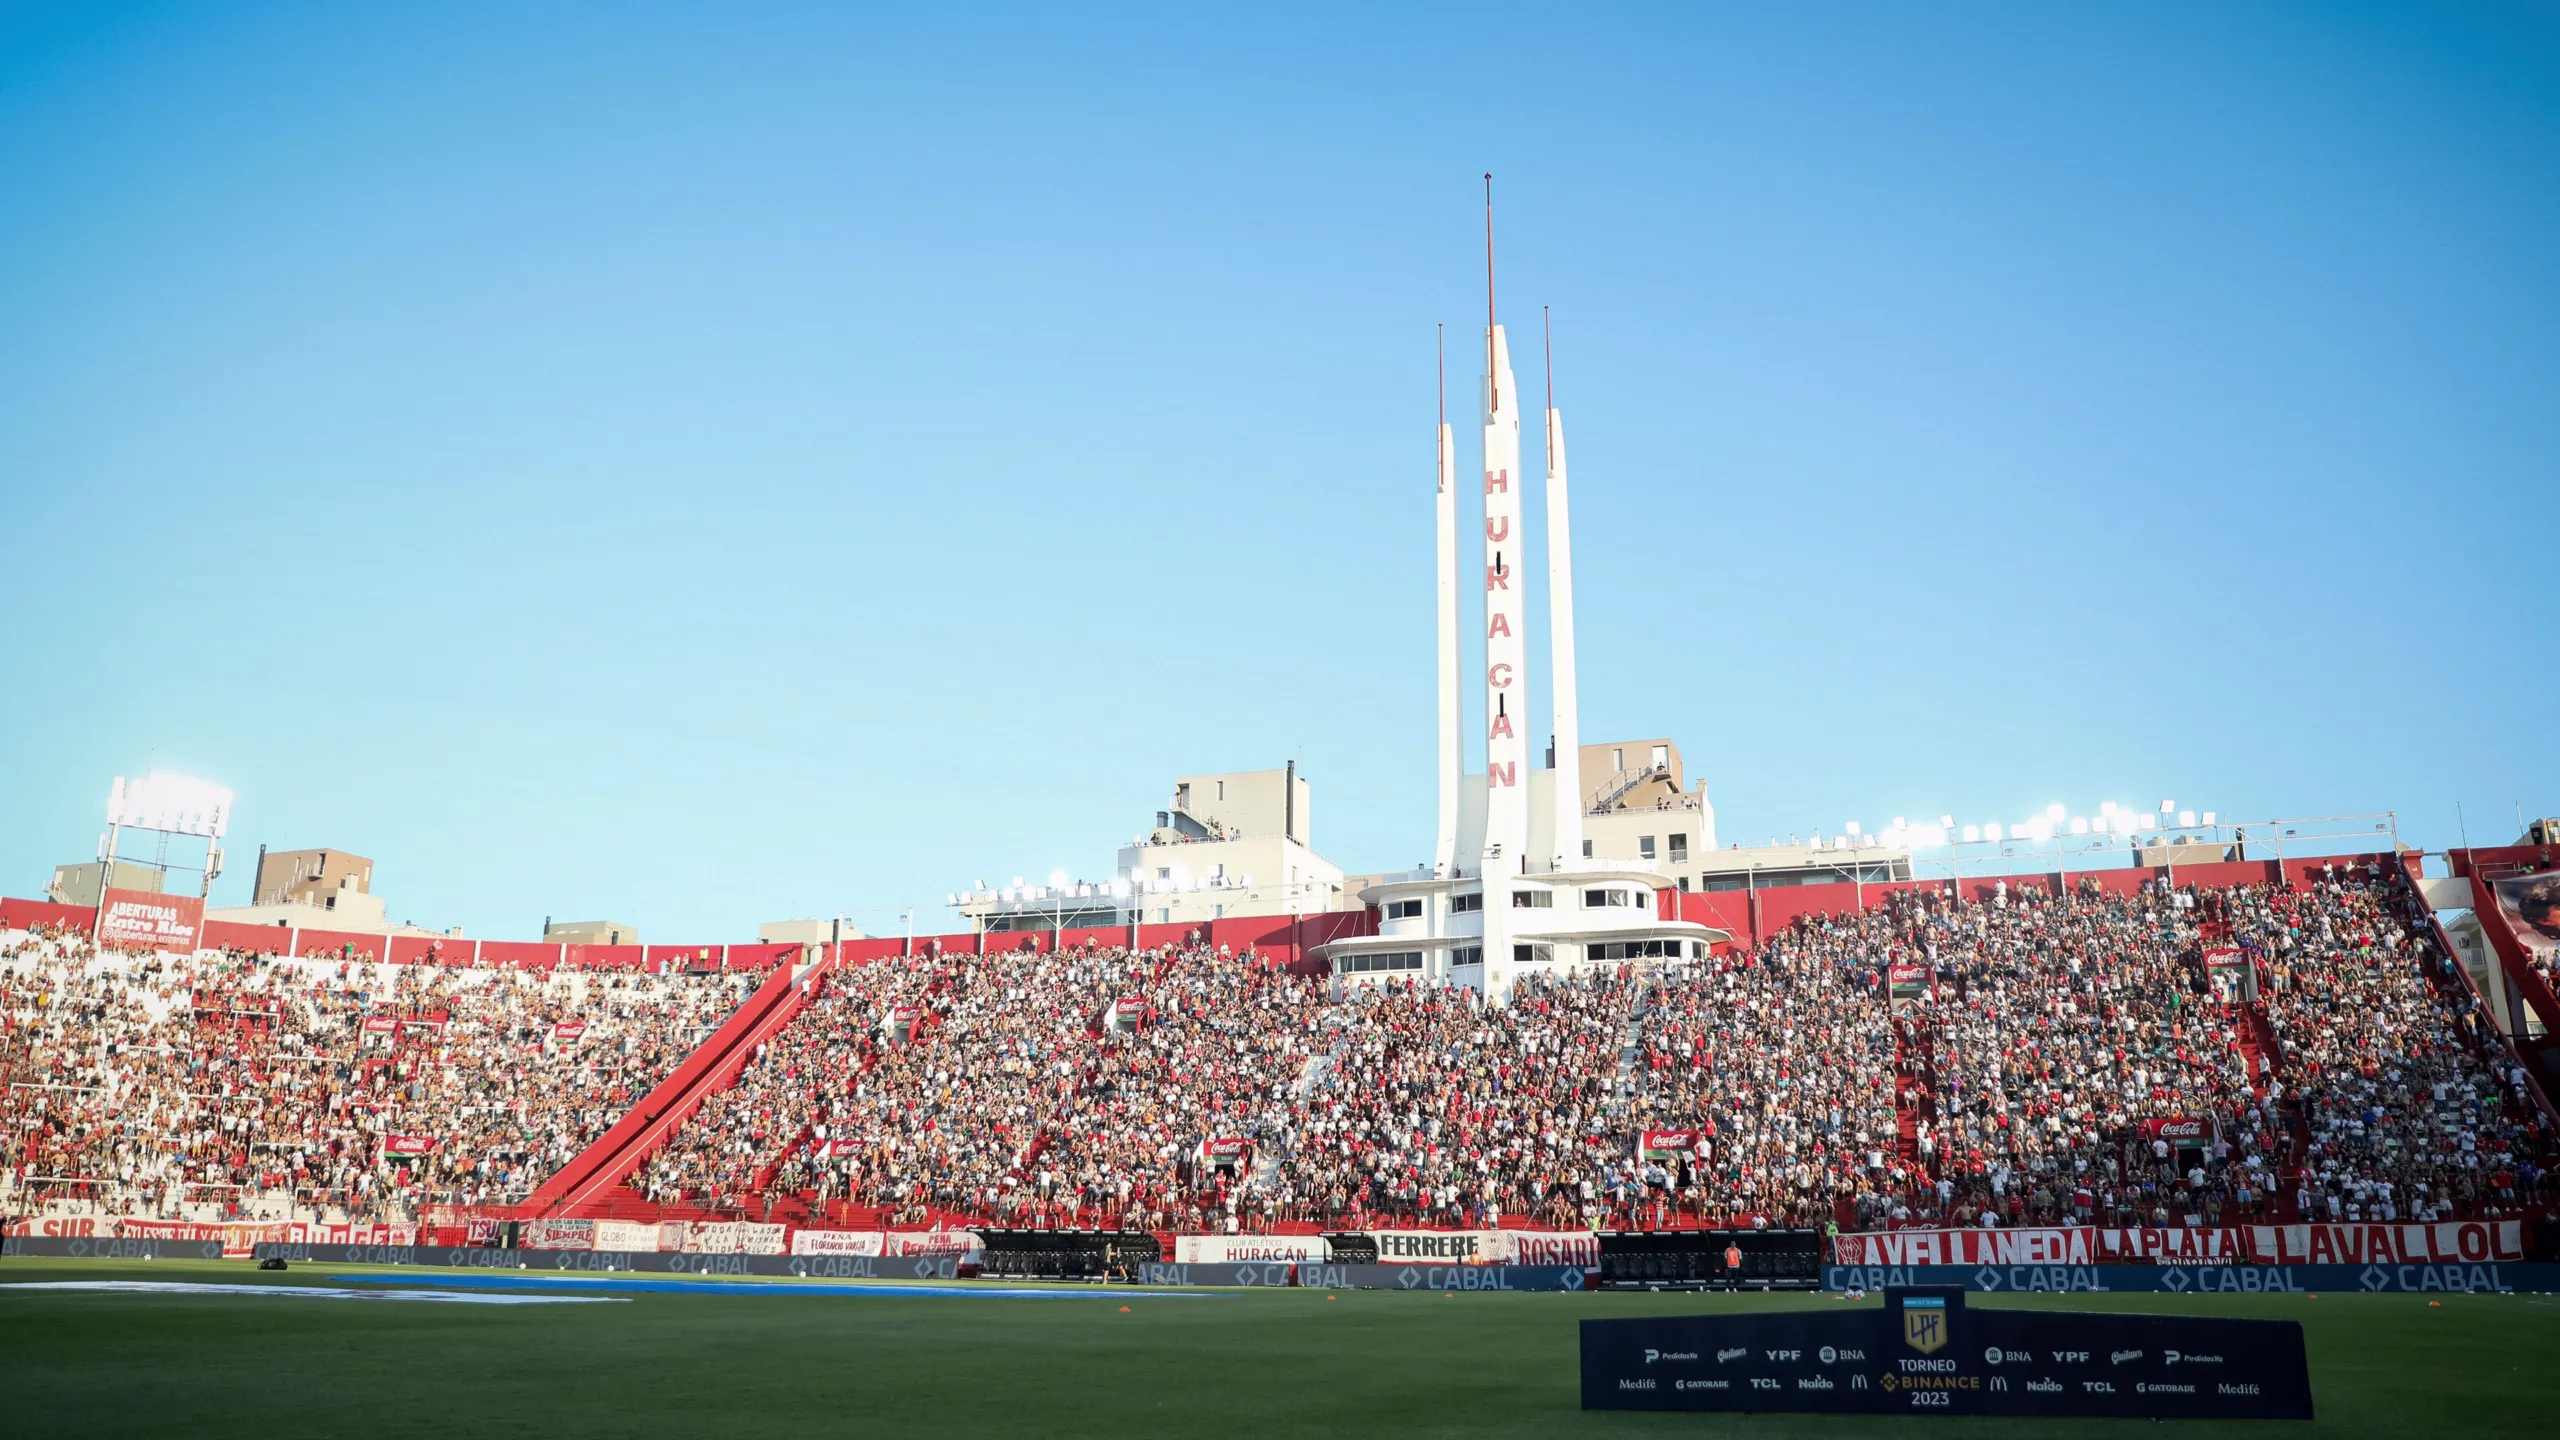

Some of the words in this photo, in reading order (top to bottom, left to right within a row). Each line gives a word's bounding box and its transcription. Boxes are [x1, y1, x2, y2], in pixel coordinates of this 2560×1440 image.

[1486, 469, 1515, 788] HURACAN
[110, 901, 177, 921] ABERTURAS
[103, 914, 153, 931] Entre
[2207, 951, 2243, 964] Coca-Cola
[1893, 967, 1926, 979] Coca-Cola
[2160, 1122, 2201, 1136] Coca-Cola
[1652, 1133, 1688, 1147] Coca-Cola
[1211, 1141, 1243, 1154] Coca-Cola
[43, 1218, 95, 1238] SUR
[544, 1227, 593, 1242] SIEMPRE
[601, 1231, 626, 1242] GLOBO
[1247, 1238, 1282, 1247] ATLÉTICO
[2139, 1229, 2238, 1257] PLATA
[2243, 1223, 2522, 1264] LLAVALLOL
[94, 1239, 164, 1258] CABAL
[1227, 1246, 1307, 1261] HURACÁN
[1865, 1230, 2089, 1265] AVELLANEDA
[365, 1246, 418, 1264] CABAL
[468, 1249, 523, 1268] CABAL
[577, 1252, 632, 1271] CABAL
[690, 1255, 753, 1275] CABAL
[812, 1257, 877, 1277] CABAL
[1428, 1267, 1513, 1289] CABAL
[2010, 1267, 2109, 1291] CABAL
[2198, 1267, 2304, 1292] CABAL
[2398, 1265, 2512, 1291] CABAL
[1662, 1352, 1698, 1360] PedidosYa
[1717, 1347, 1747, 1363] Quilmes
[1765, 1350, 1801, 1361] YPF
[1839, 1350, 1865, 1360] BNA
[2005, 1351, 2032, 1362] BNA
[2052, 1351, 2090, 1362] YPF
[2111, 1349, 2143, 1364] Quilmes
[2184, 1354, 2223, 1363] PedidosYa
[1898, 1359, 1956, 1371] TORNEO
[1619, 1378, 1656, 1389] Medifé
[1686, 1380, 1729, 1388] GATORADE
[1750, 1379, 1781, 1388] TCL
[1798, 1375, 1833, 1389] Naldo
[1902, 1376, 1980, 1389] BINANCE
[2027, 1377, 2063, 1392] Naldo
[2083, 1382, 2116, 1392] TCL
[2148, 1384, 2196, 1393] GATORADE
[2218, 1384, 2260, 1394] Medifé
[1911, 1392, 1950, 1405] 2023
